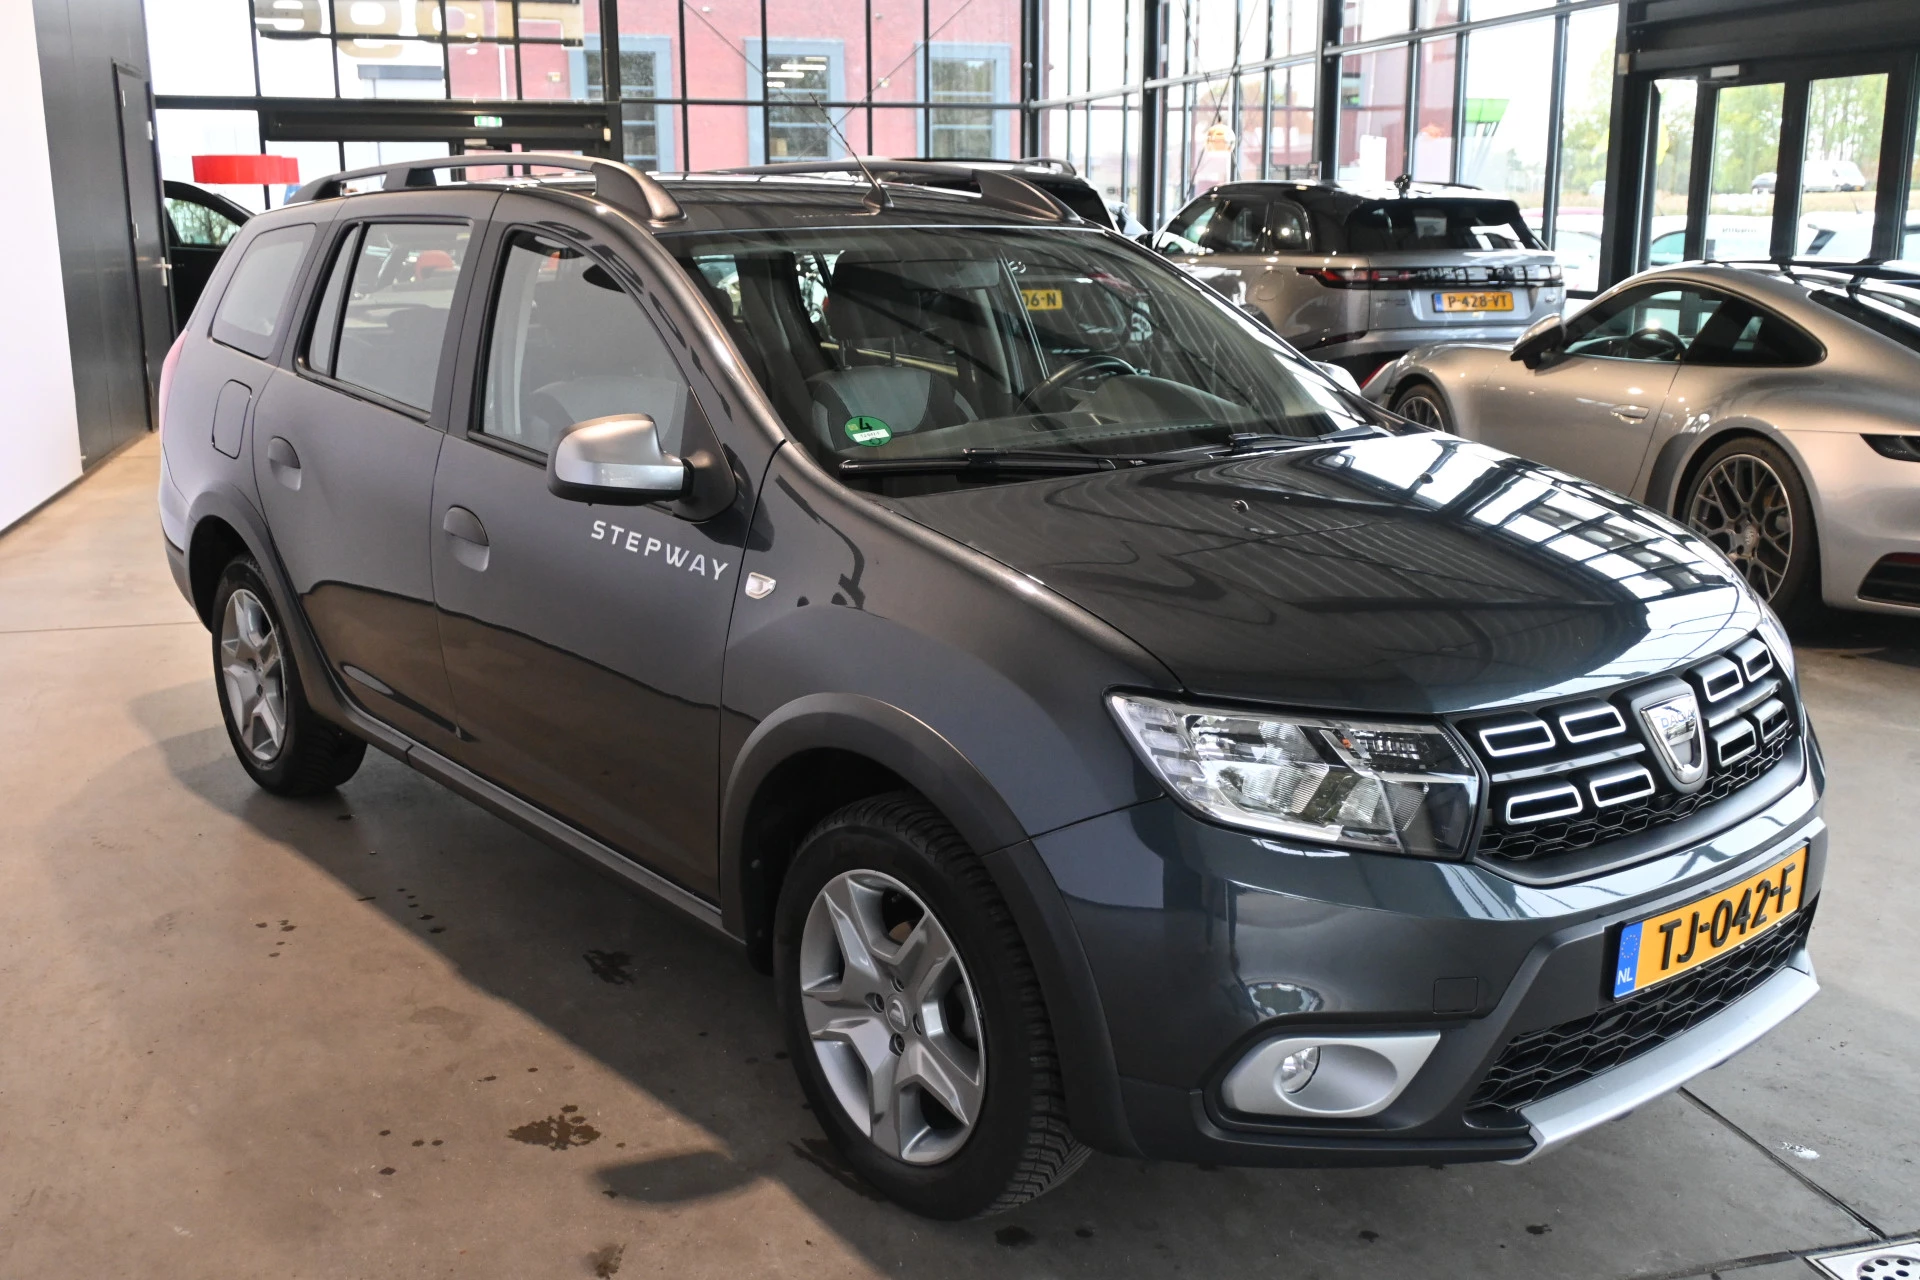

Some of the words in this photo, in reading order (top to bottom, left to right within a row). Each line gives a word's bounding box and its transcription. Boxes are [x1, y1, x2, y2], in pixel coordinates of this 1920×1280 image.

[1448, 294, 1508, 308] P-428-VT
[859, 417, 873, 431] 4
[591, 520, 728, 580] STEPWAY
[1659, 862, 1796, 971] TJ-042-F
[1617, 967, 1633, 985] NL
